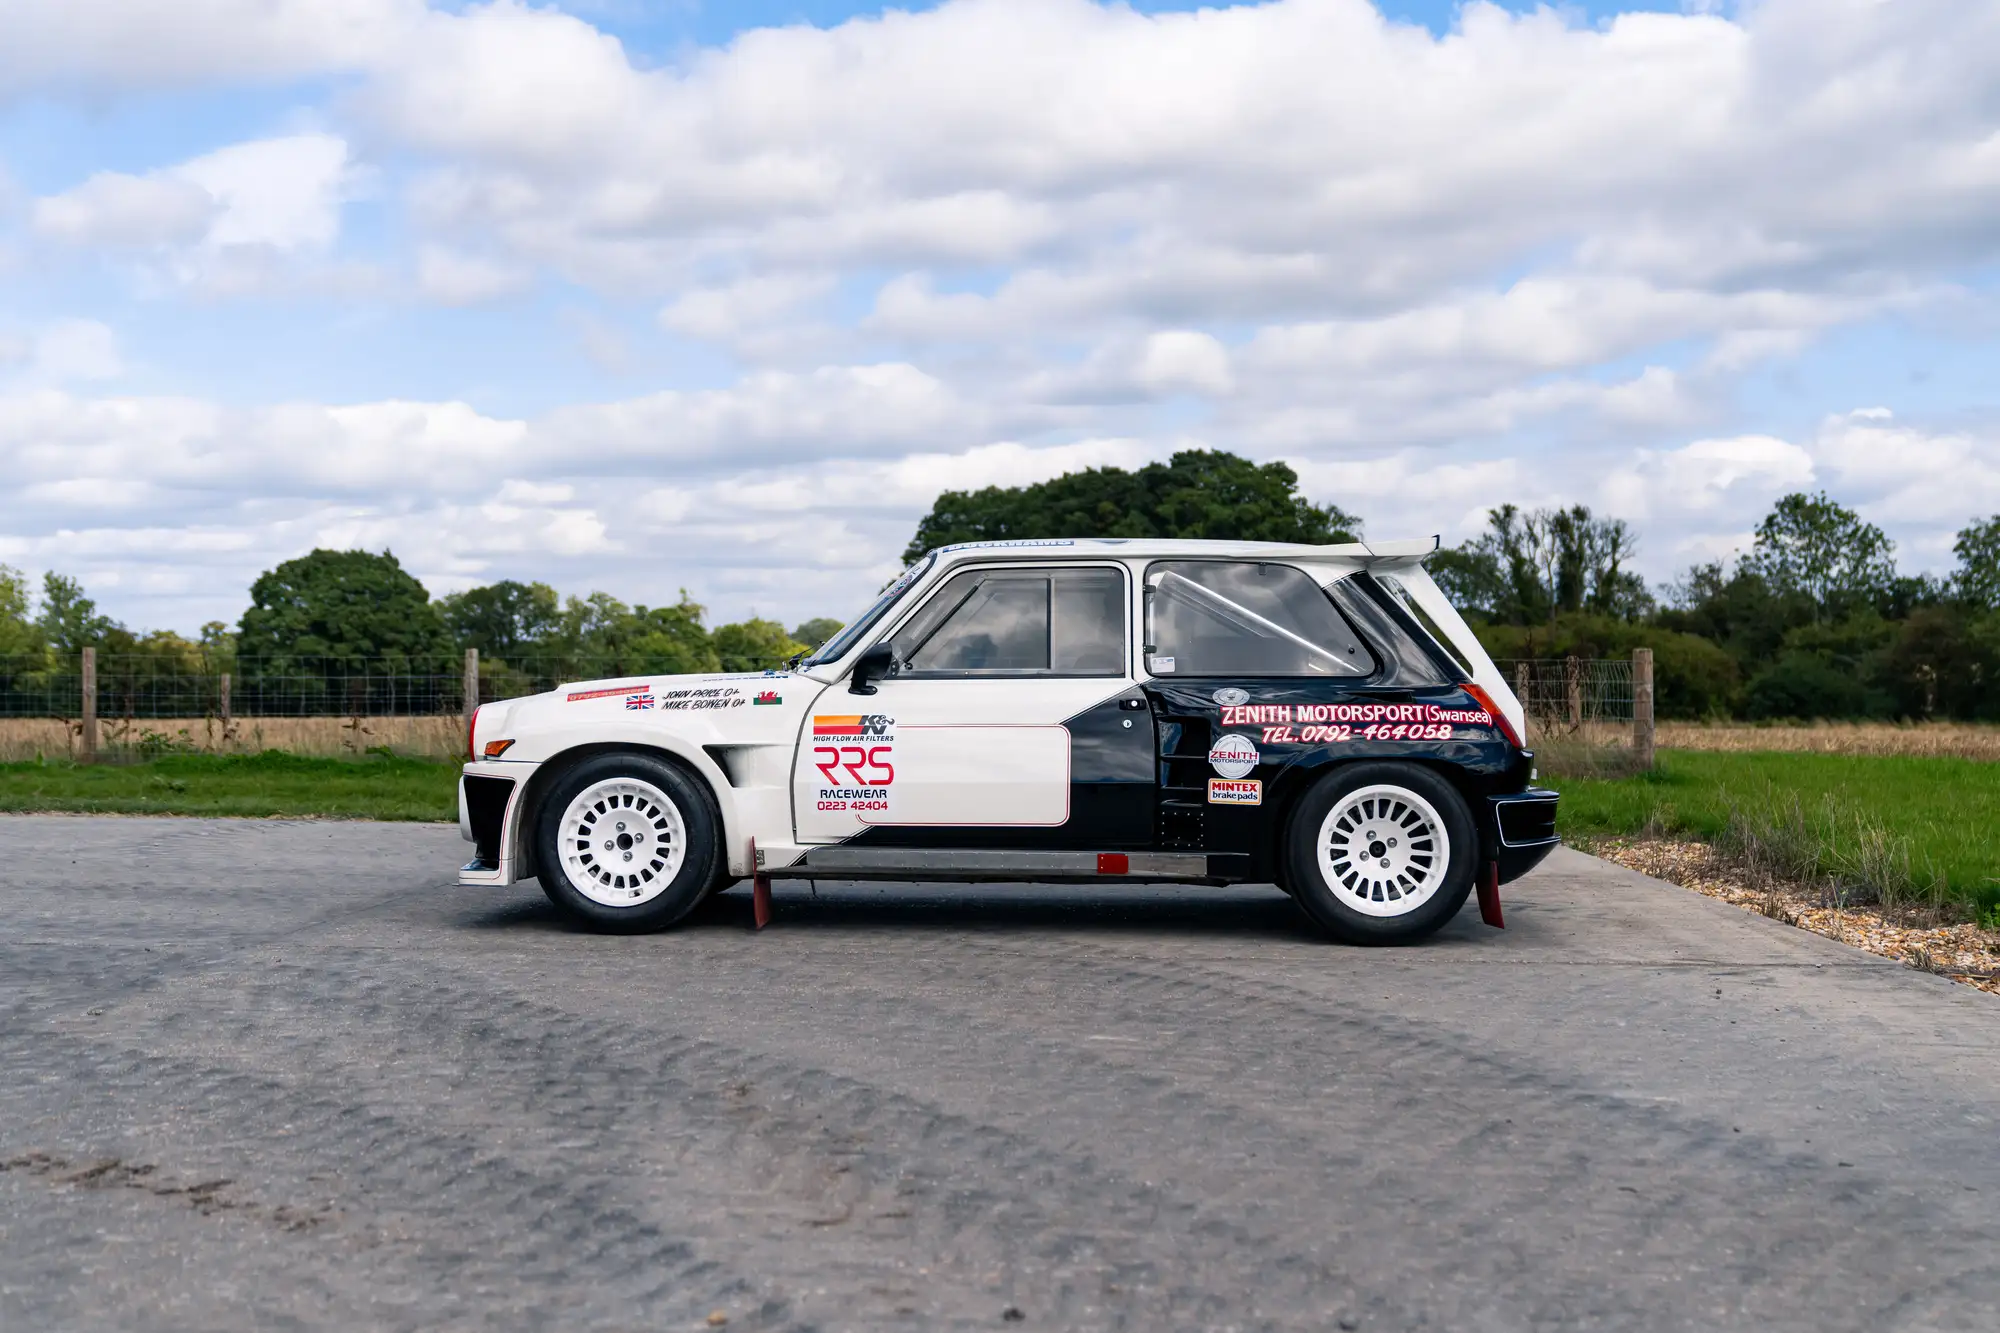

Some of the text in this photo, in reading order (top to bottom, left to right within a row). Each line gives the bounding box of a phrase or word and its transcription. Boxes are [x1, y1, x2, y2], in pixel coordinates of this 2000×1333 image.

[662, 690, 692, 700] JOHN
[690, 688, 723, 698] PRICE
[661, 700, 692, 710] MIKE
[692, 698, 731, 710] BOWEN
[1221, 705, 1291, 726] ZENITH
[1297, 704, 1424, 723] MOTORSPORT
[1210, 750, 1258, 760] ZENITH
[813, 746, 894, 786] RRS
[1212, 782, 1257, 792] MINTEX
[820, 789, 887, 799] RACEWEAR
[1212, 791, 1258, 801] brake pads
[817, 801, 888, 811] 0223 42404
